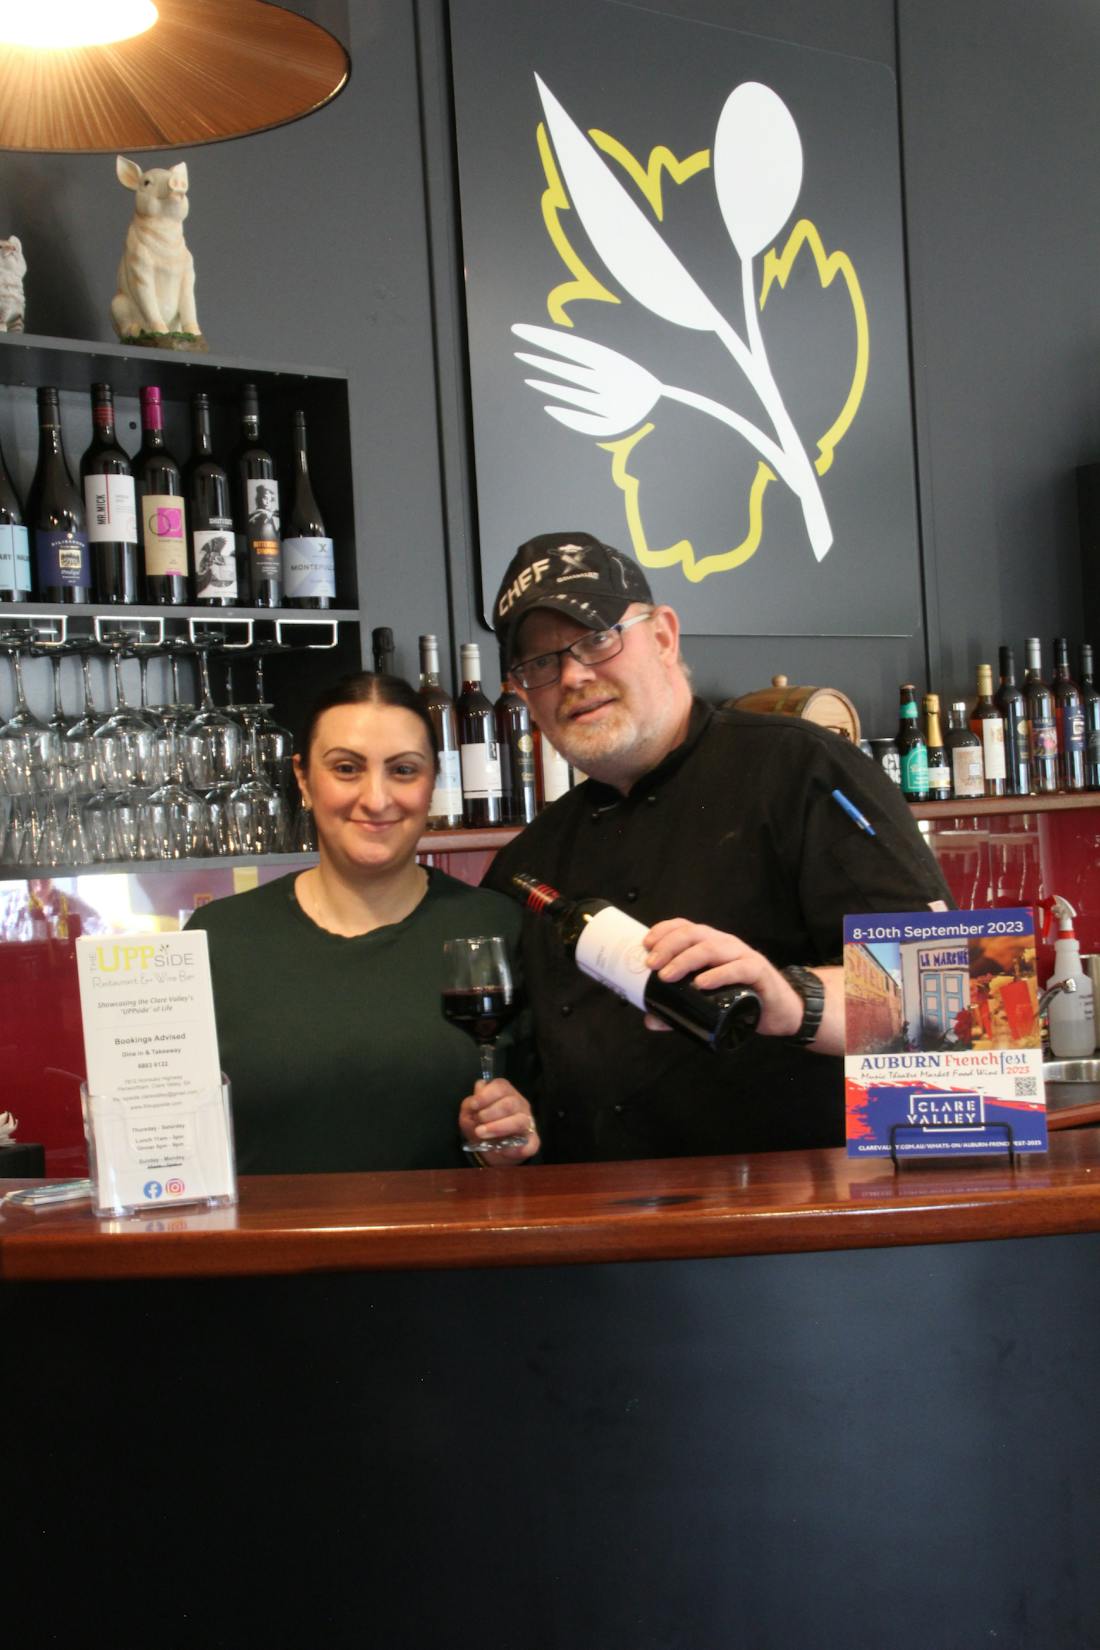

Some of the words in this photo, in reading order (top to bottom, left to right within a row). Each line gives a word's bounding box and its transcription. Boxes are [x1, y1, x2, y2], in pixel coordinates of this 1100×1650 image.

[96, 494, 106, 513] MICK
[499, 558, 550, 617] CHEF
[852, 926, 901, 940] 8-10th
[904, 924, 985, 940] September
[987, 921, 1024, 934] 2023
[97, 999, 137, 1009] Showcasing
[150, 996, 167, 1004] Clare
[162, 1004, 173, 1012] Life
[114, 1036, 152, 1046] Bookings
[154, 1033, 186, 1041] Advised
[152, 1047, 182, 1055] Takeaway
[861, 1054, 941, 1070] AUBURN
[952, 1069, 973, 1077] Food
[976, 1068, 998, 1076] Wine
[1006, 1065, 1030, 1075] 2023
[917, 1100, 977, 1113] CLARE
[906, 1112, 977, 1125] VALLEY
